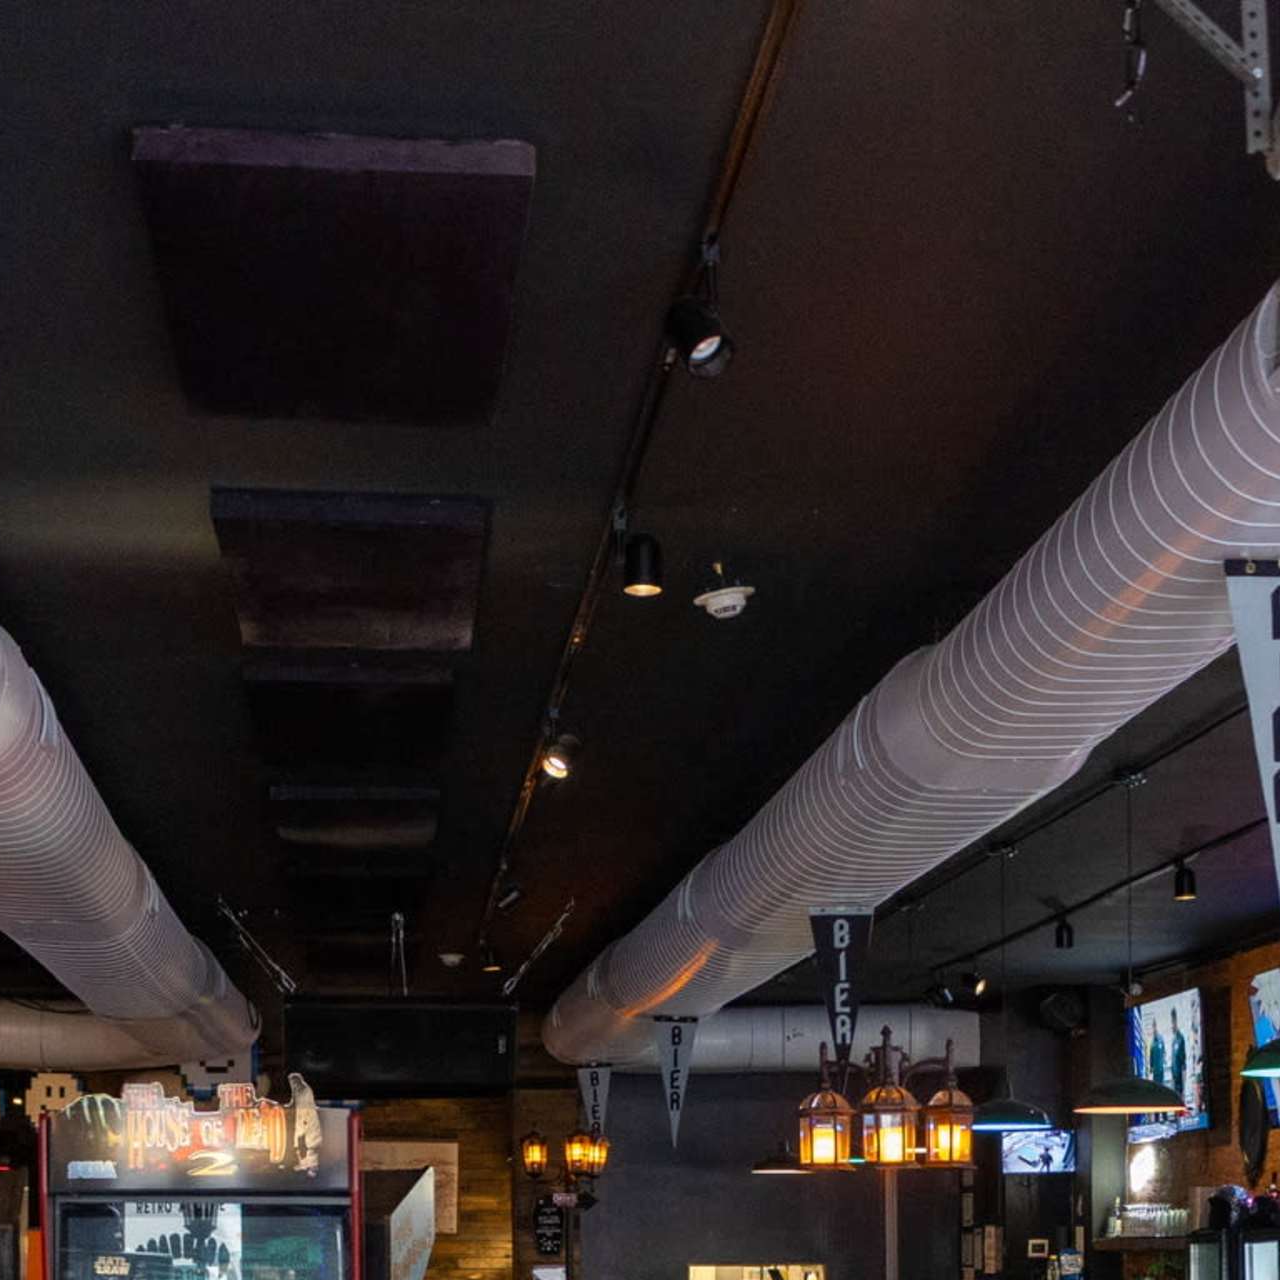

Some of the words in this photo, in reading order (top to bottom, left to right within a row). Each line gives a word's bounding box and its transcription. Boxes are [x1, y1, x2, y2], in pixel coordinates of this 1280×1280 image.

[832, 918, 851, 1046] BIER
[124, 1084, 161, 1109] THE
[221, 1084, 255, 1109] THE
[668, 1025, 683, 1111] BIER
[201, 1118, 225, 1147] OF
[235, 1101, 287, 1163] DEAD
[589, 1070, 601, 1136] BIER
[128, 1104, 191, 1168] HOUSE
[187, 1150, 239, 1177] 2
